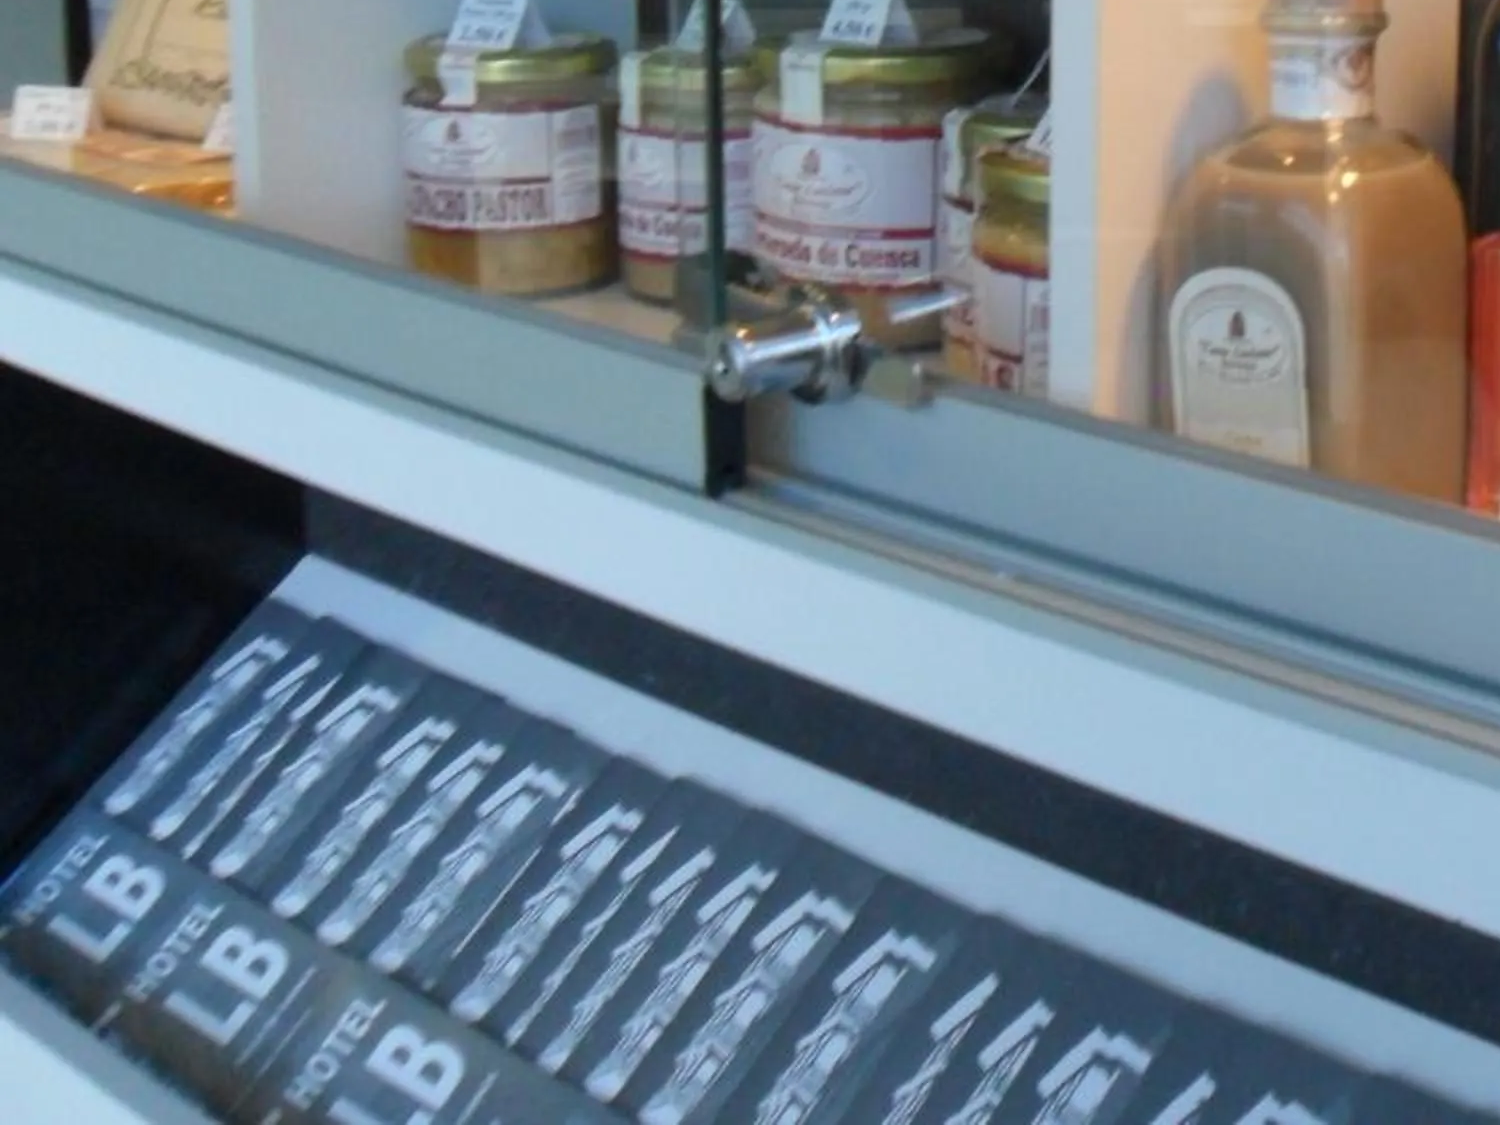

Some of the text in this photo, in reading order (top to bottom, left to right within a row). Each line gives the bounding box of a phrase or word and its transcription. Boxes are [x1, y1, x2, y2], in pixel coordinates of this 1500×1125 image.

[13, 834, 111, 926] HOTEL
[47, 853, 167, 964] LB
[123, 903, 225, 1003] HOTEL
[162, 923, 290, 1047] LB
[283, 997, 390, 1111] HOTEL
